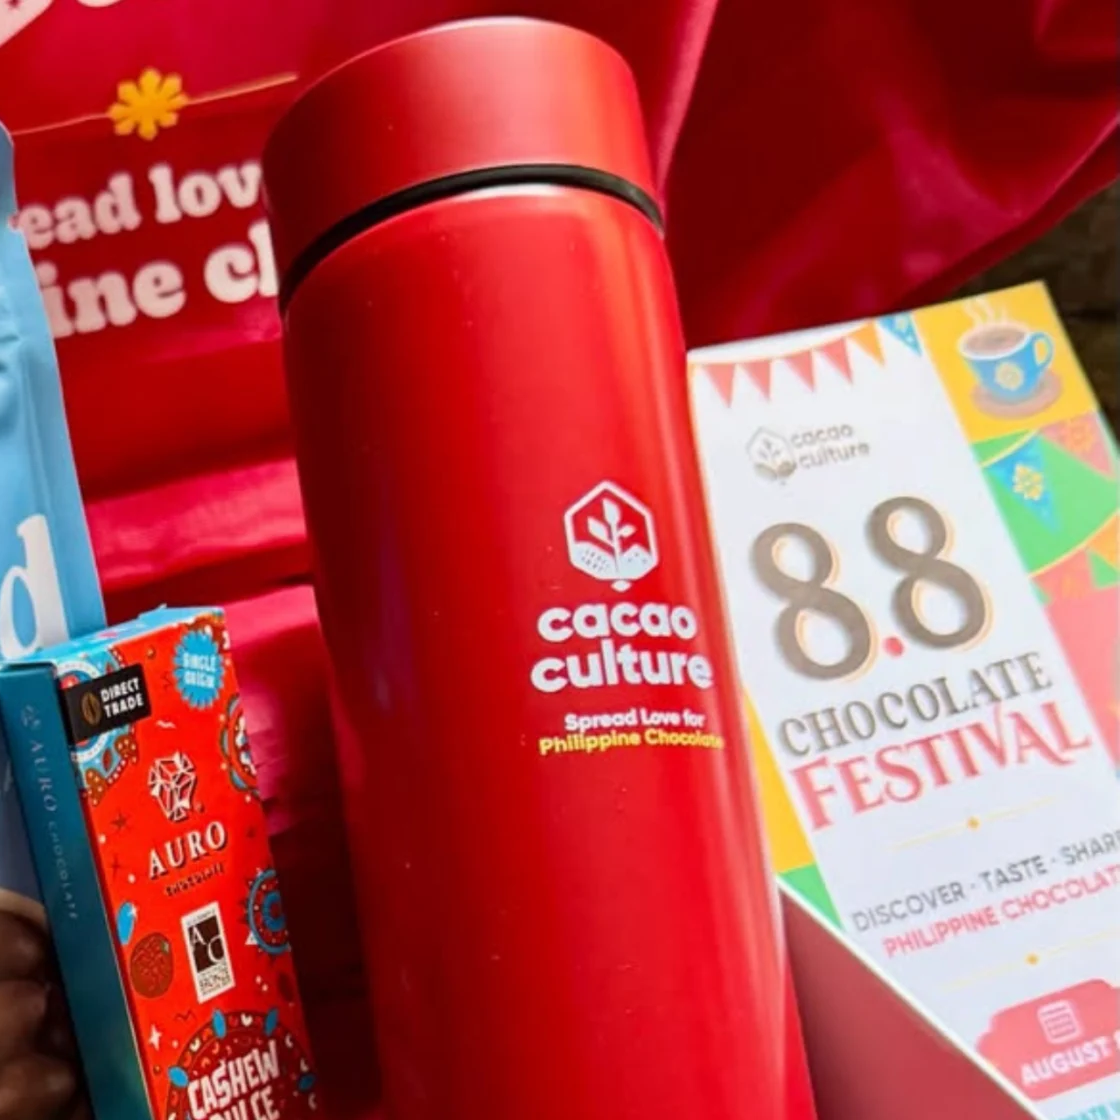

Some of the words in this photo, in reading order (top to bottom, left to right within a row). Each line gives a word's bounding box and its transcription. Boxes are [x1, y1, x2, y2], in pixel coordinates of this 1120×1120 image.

[148, 160, 263, 224] lov
[35, 260, 186, 340] ine
[791, 424, 854, 448] cacao
[799, 443, 869, 469] culture
[748, 495, 994, 683] 8.8
[537, 602, 697, 643] cacao
[100, 677, 139, 703] DIRECT
[530, 638, 713, 693] culture
[103, 692, 144, 719] TRADE
[564, 707, 637, 733] Spread
[640, 706, 680, 726] Love
[683, 708, 705, 728] for
[780, 652, 1053, 759] CHOCOLATE
[539, 730, 640, 756] Philippine
[789, 700, 1092, 832] FESTIVAL
[148, 820, 227, 881] AURO
[851, 882, 966, 933] DISCOVER
[978, 854, 1048, 893] TASTE
[883, 906, 1000, 959] PHILIPPINE
[1001, 863, 1120, 920] CHOCOLAT
[187, 1039, 280, 1120] CASHEW
[1021, 1035, 1112, 1086] AUGUST
